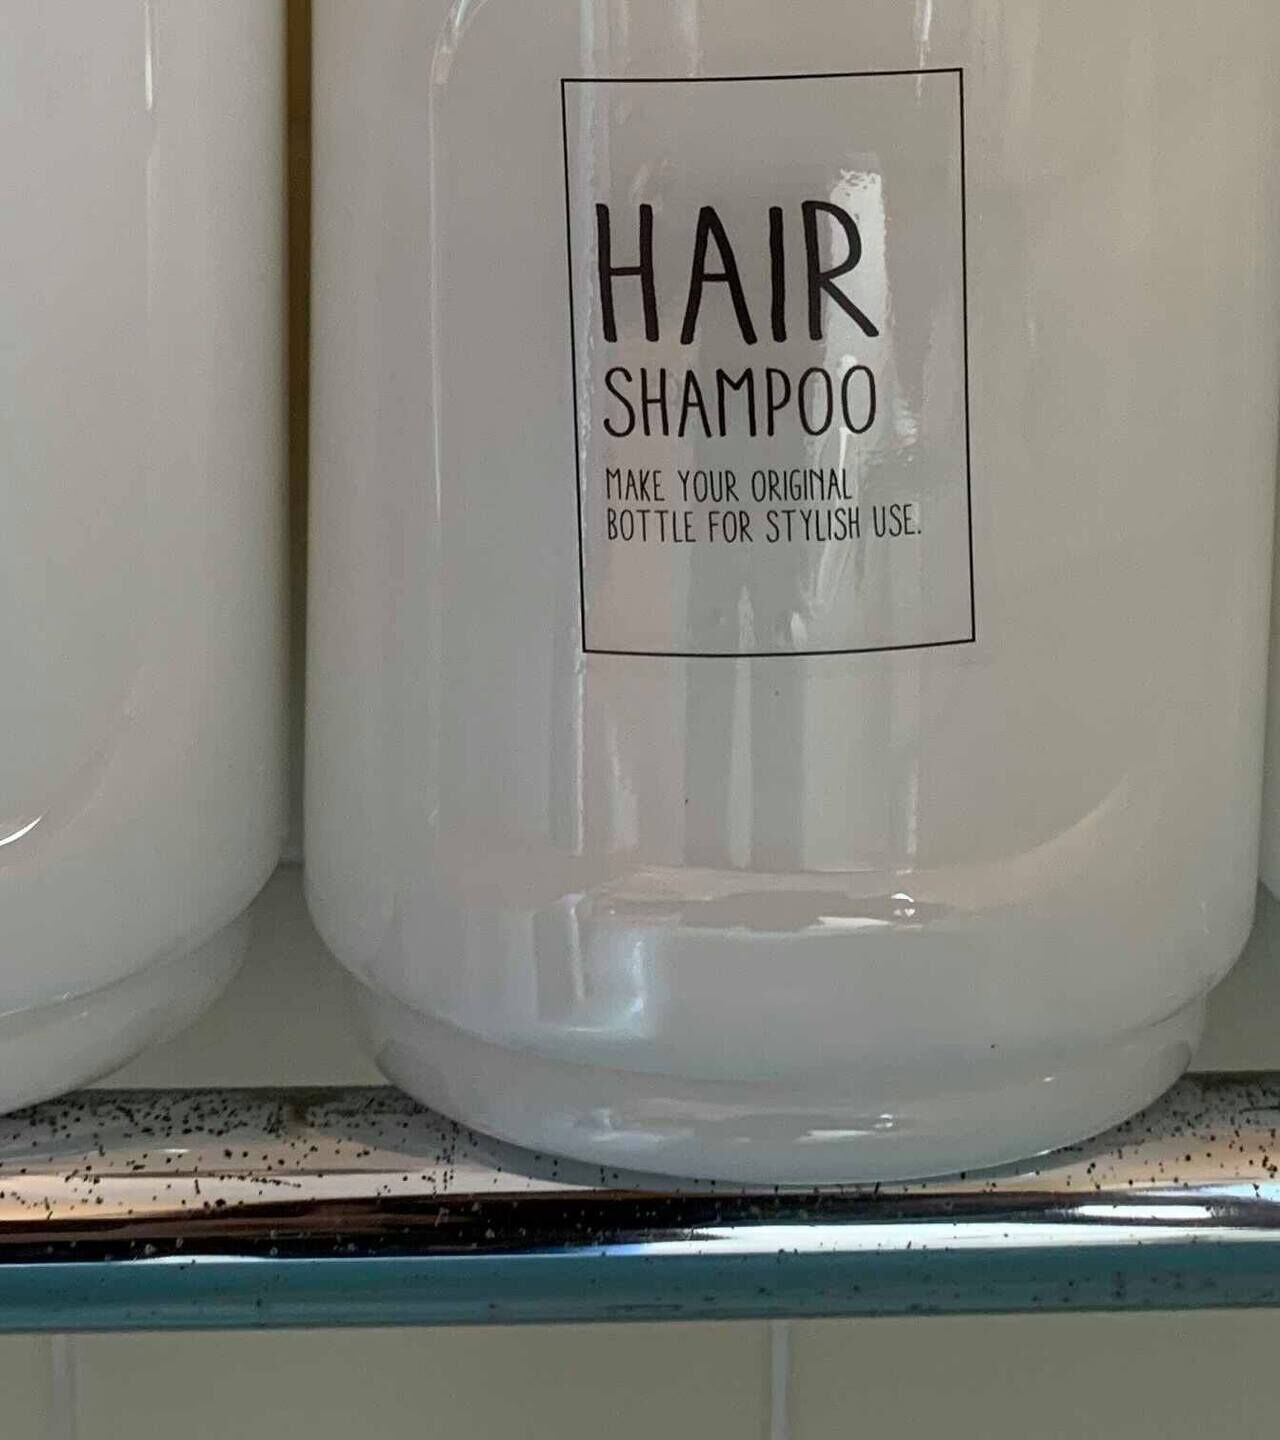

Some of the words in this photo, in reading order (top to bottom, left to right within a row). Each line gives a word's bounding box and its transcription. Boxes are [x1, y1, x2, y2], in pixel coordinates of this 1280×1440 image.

[595, 200, 880, 345] HAIR
[603, 364, 877, 439] SHAMPOO
[606, 467, 663, 502] MAKE
[677, 469, 739, 503] YOUR
[751, 468, 853, 501] ORIGINAL
[607, 508, 697, 544] BOTTLE
[709, 510, 754, 544] FOR
[766, 506, 860, 543] STYLISH
[873, 503, 922, 537] USE.
